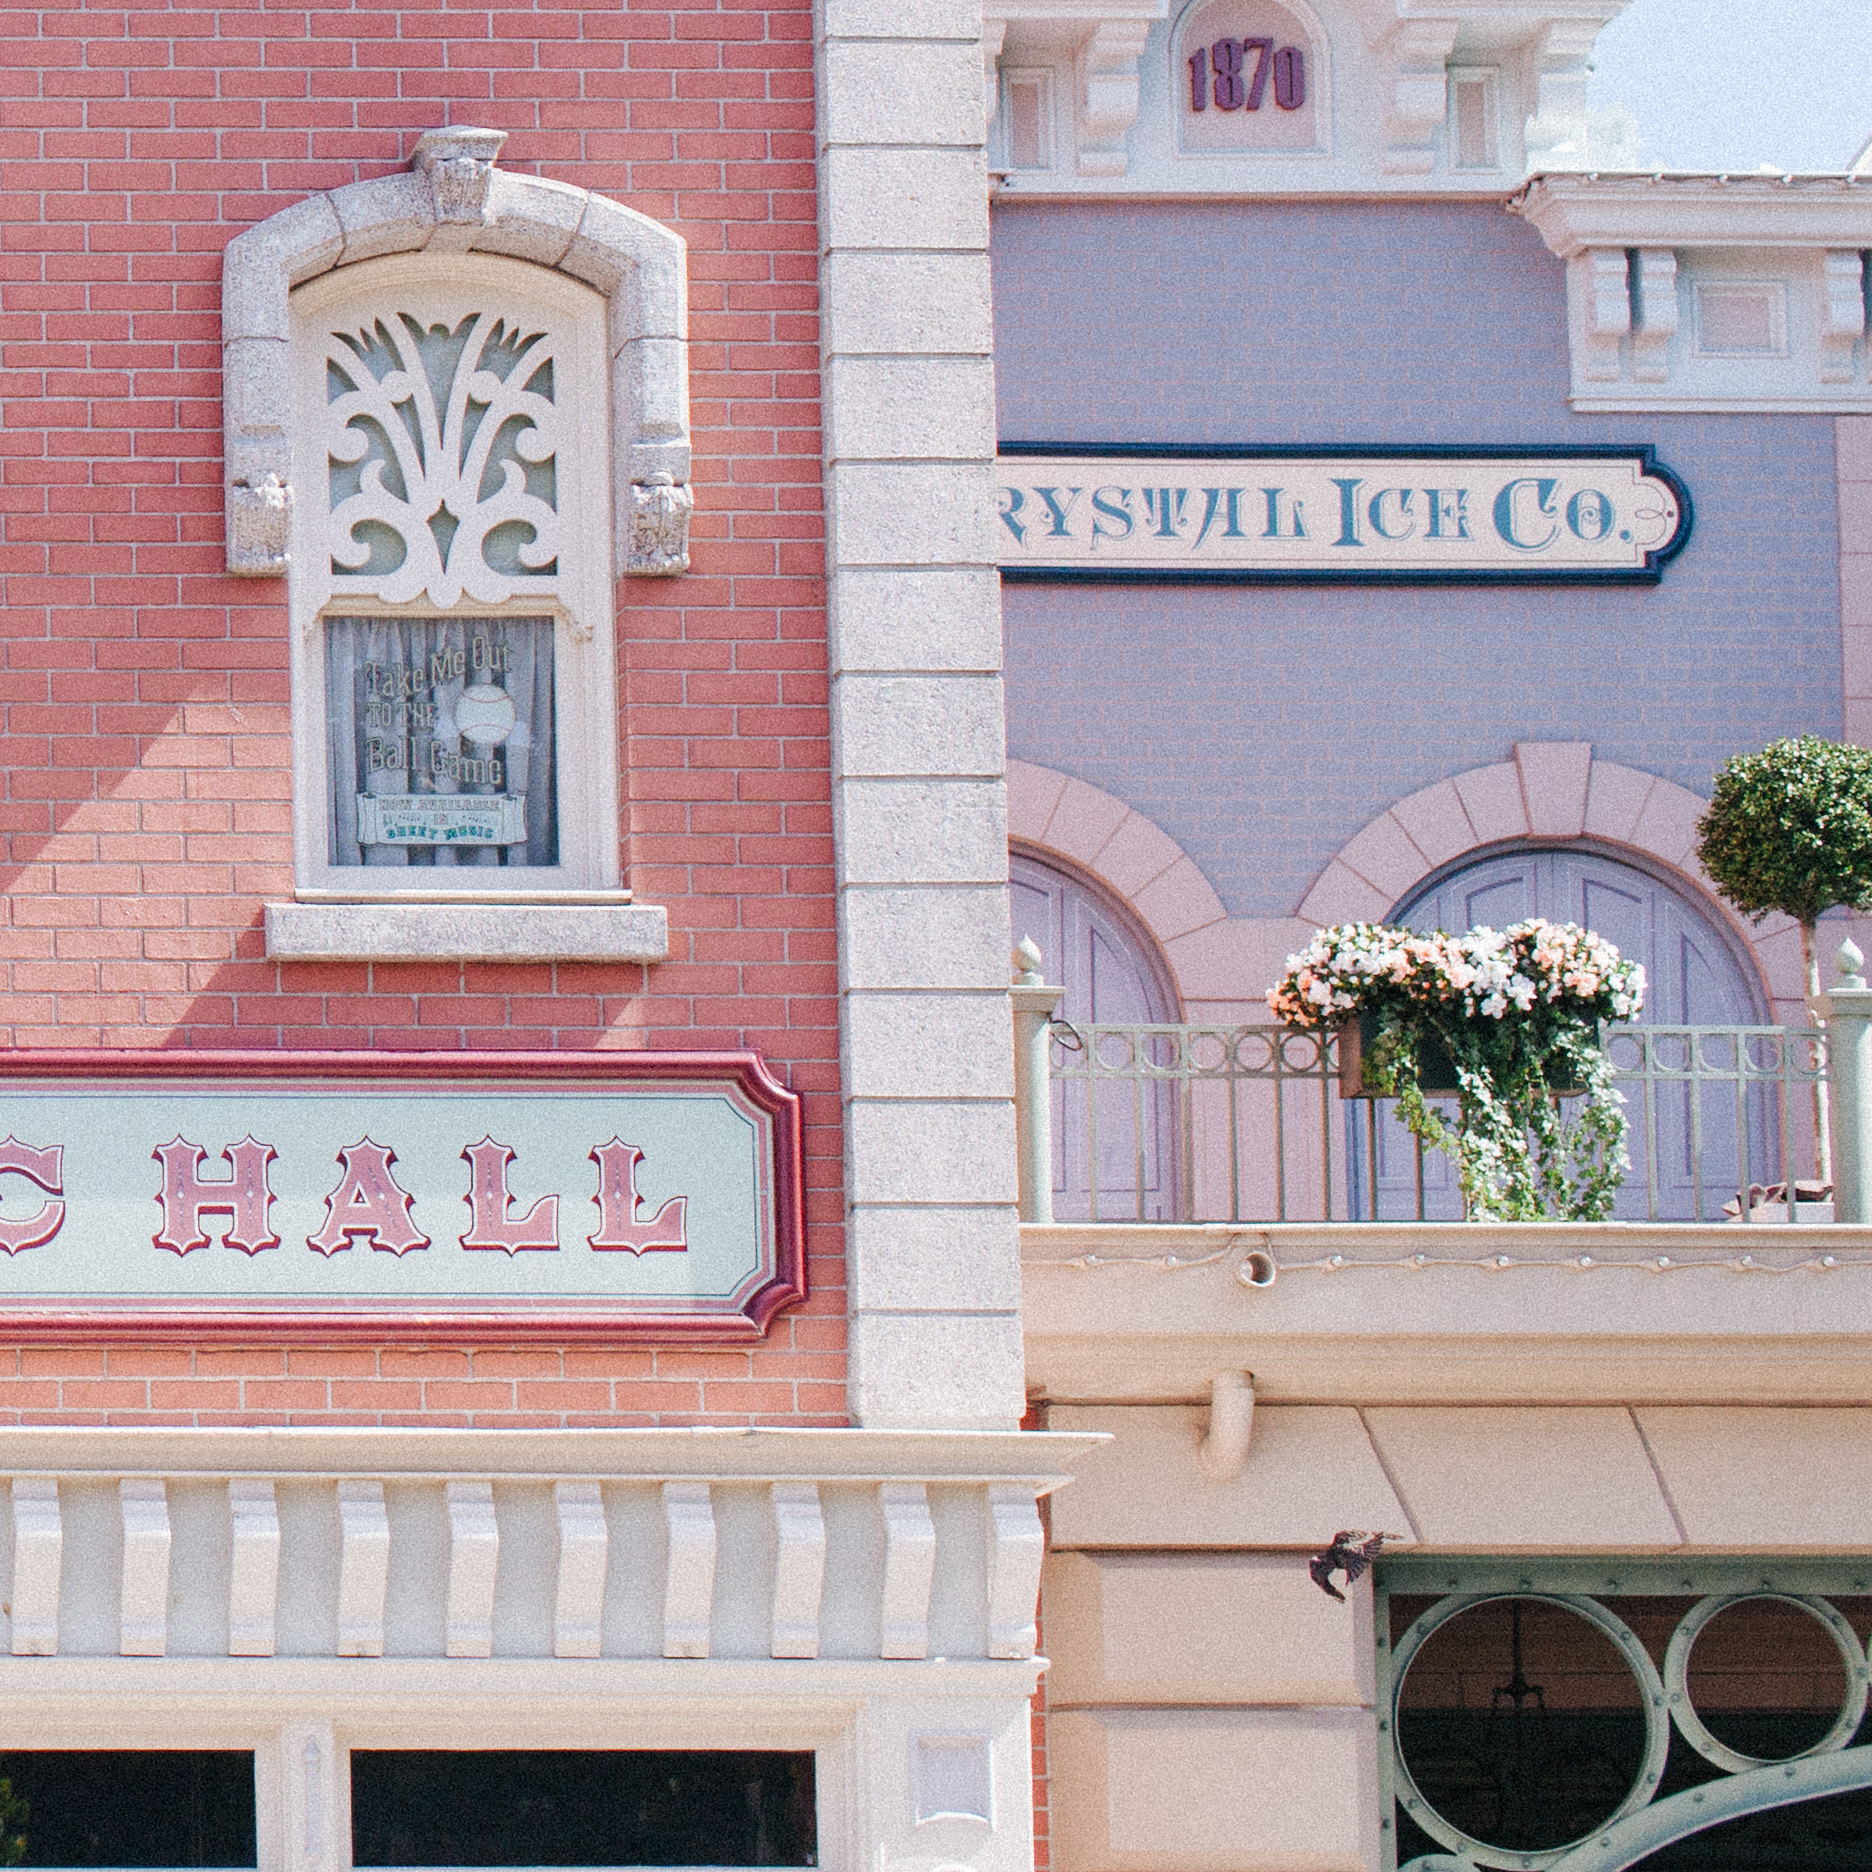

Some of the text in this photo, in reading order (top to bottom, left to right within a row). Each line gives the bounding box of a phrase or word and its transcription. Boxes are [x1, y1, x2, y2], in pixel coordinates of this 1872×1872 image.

[1187, 36, 1306, 113] 1870
[365, 636, 514, 699] Take Me Out
[366, 702, 438, 728] TO THE
[365, 735, 503, 786] Ball Game
[443, 825, 494, 840] MUSIC
[151, 1132, 689, 1258] HALL
